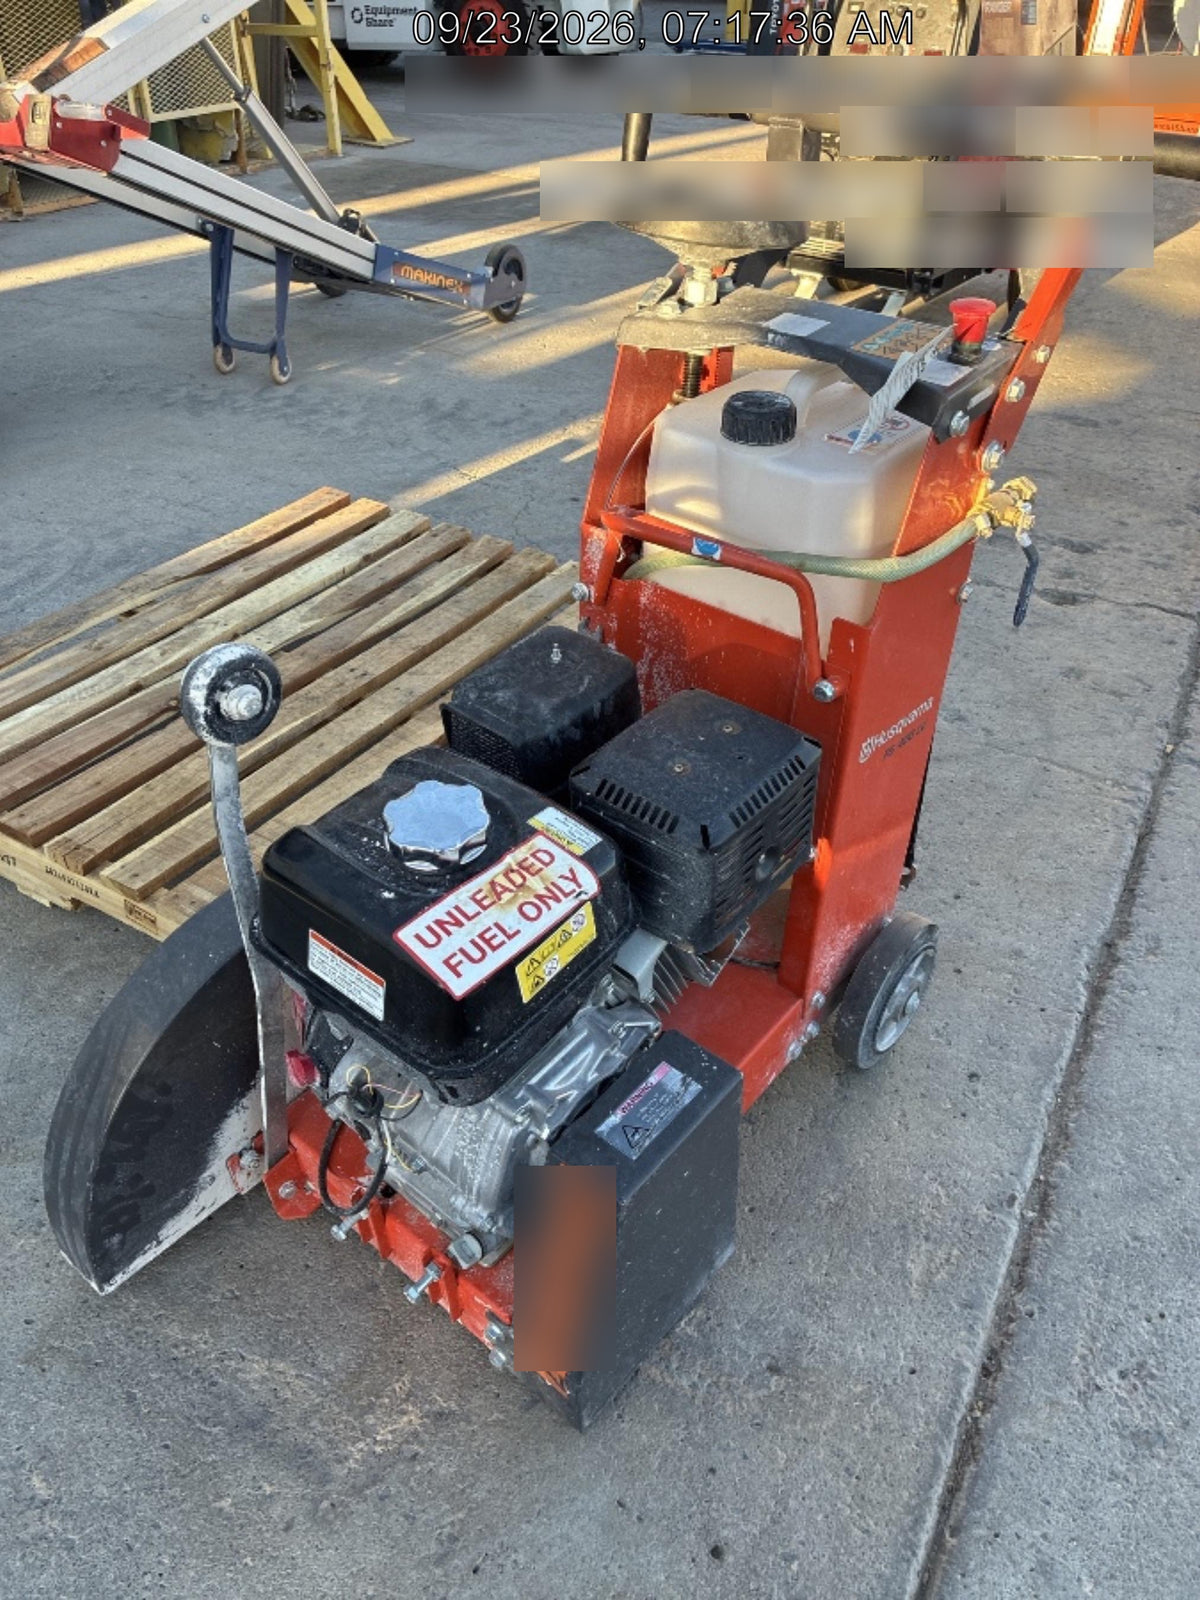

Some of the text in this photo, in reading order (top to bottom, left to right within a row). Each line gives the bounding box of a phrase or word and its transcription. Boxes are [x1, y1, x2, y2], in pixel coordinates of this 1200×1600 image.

[364, 5, 418, 17] Equipment
[365, 17, 395, 27] Share
[400, 264, 464, 294] MAKINEX
[413, 848, 556, 949] UNLEADED
[441, 921, 522, 979] FUEL
[517, 867, 583, 923] ONLY
